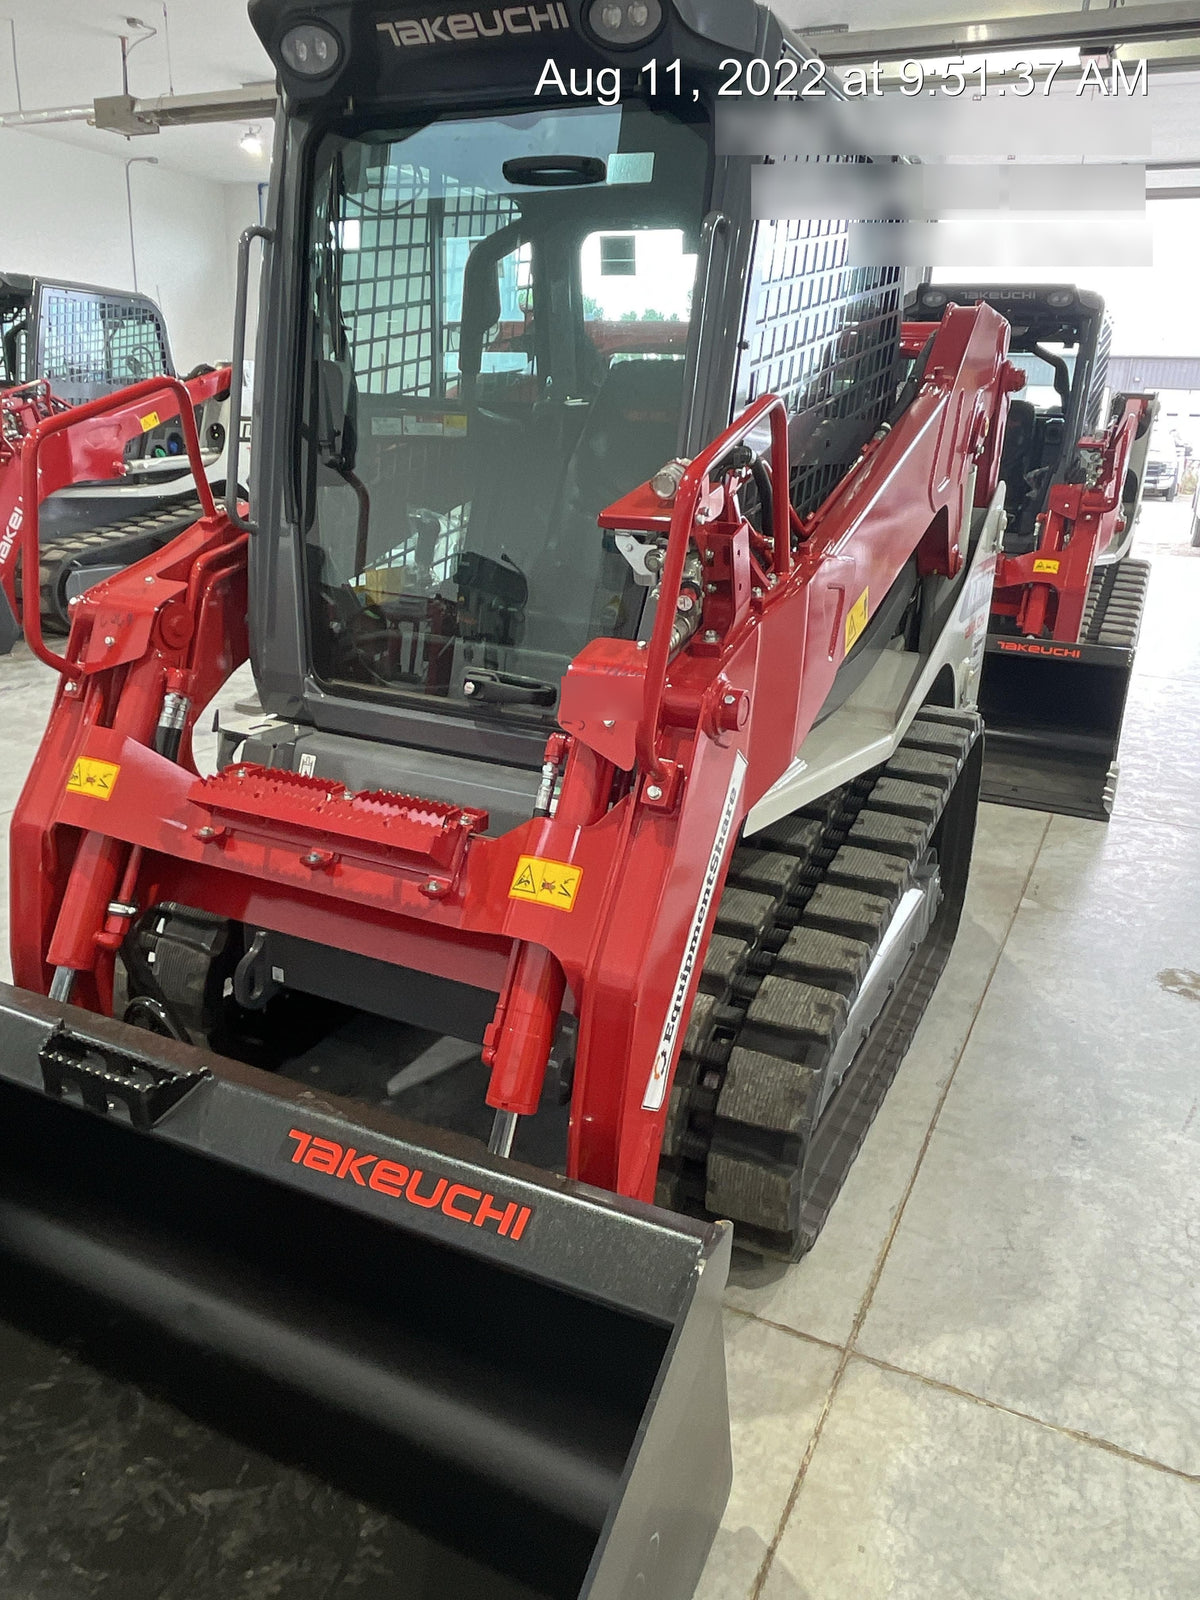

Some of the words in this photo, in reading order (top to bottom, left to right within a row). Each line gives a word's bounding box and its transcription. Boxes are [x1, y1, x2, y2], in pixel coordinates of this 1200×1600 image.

[375, 2, 570, 47] TAKEUCHI
[997, 640, 1081, 659] TAKEUCHI
[662, 786, 738, 1044] EquipmentShare
[287, 1128, 533, 1241] TAKEUCHI
